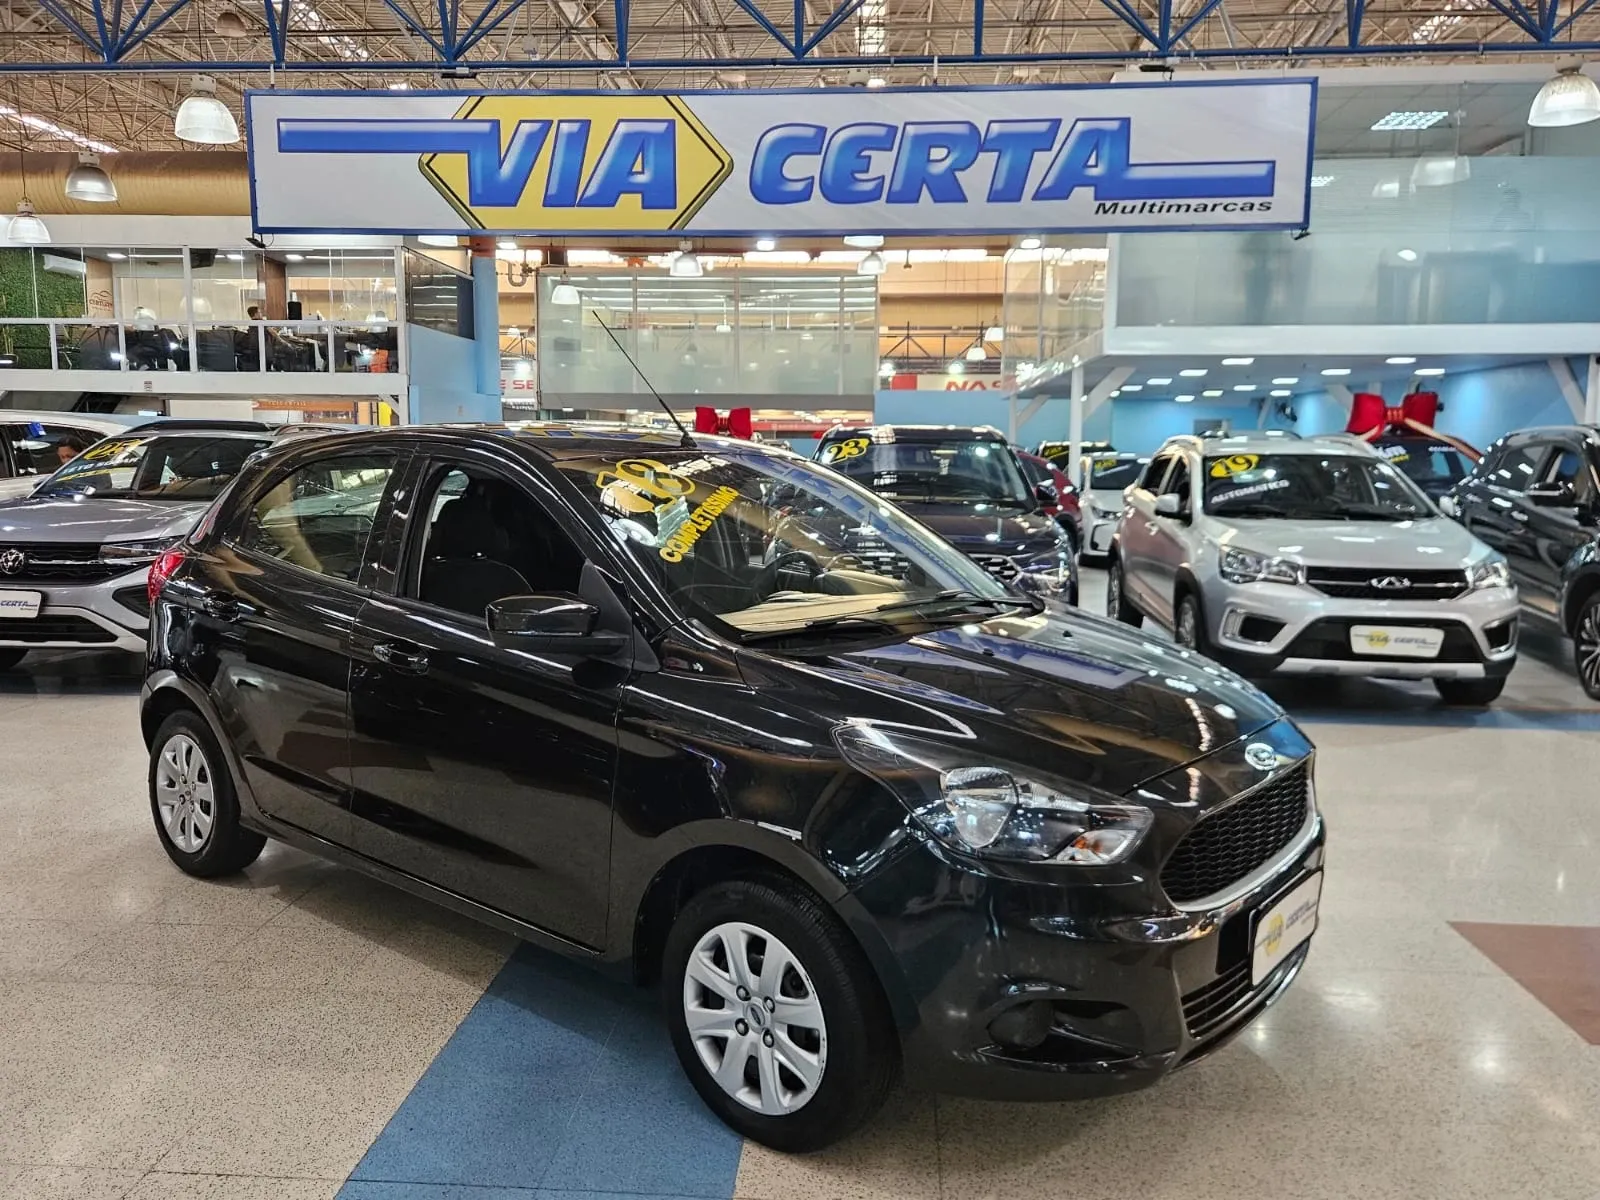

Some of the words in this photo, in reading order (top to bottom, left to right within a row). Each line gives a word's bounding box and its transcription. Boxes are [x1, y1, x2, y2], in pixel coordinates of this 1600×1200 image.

[467, 119, 677, 209] VIA
[749, 117, 1131, 205] CERTA
[1094, 201, 1273, 215] Multimarcas
[827, 440, 866, 463] 23
[1216, 455, 1254, 476] 19
